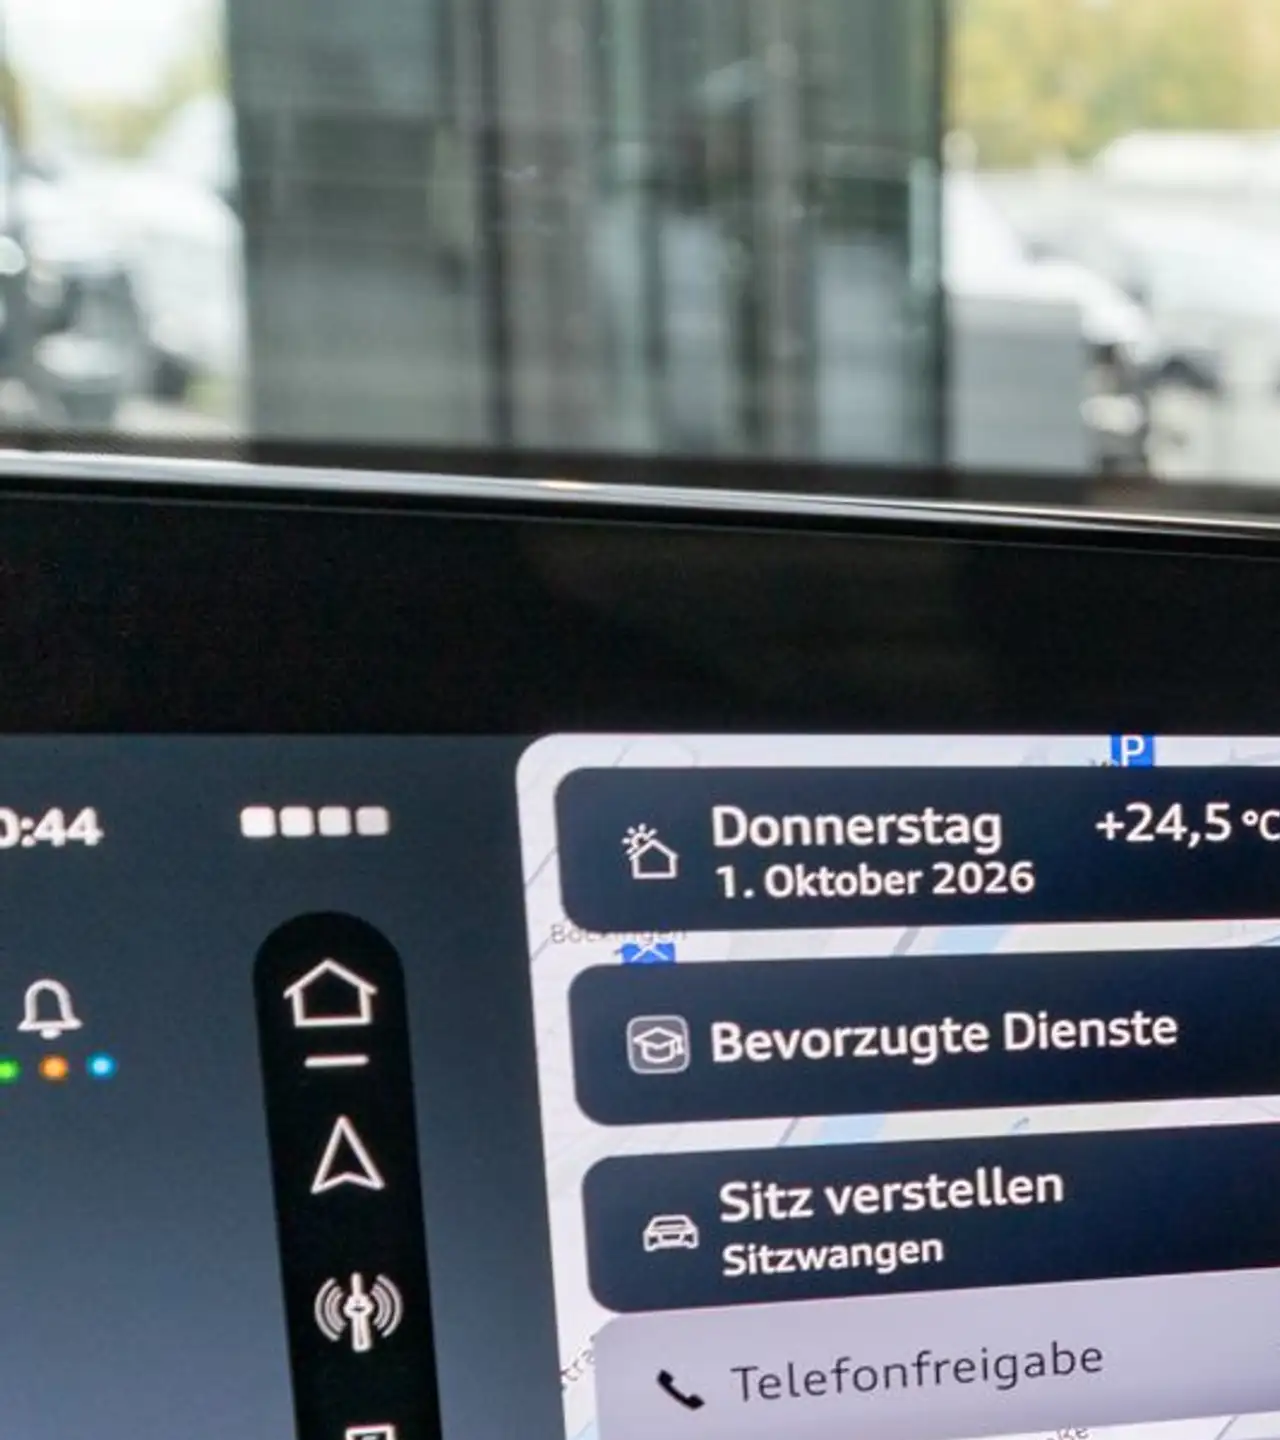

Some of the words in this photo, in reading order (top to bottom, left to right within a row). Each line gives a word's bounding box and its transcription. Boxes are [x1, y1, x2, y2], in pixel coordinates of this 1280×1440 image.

[712, 805, 1002, 855] Donnerstag
[715, 865, 755, 899] 1.
[765, 862, 923, 898] Oktober
[932, 861, 1035, 894] 2026
[711, 1017, 990, 1066] Bevorzugte
[1004, 1010, 1178, 1051] Dienste
[720, 1181, 814, 1223] Sitz
[824, 1166, 1063, 1215] verstellen
[722, 1237, 944, 1277] Sitzwangen
[730, 1340, 1103, 1402] Telefonfreigabe
